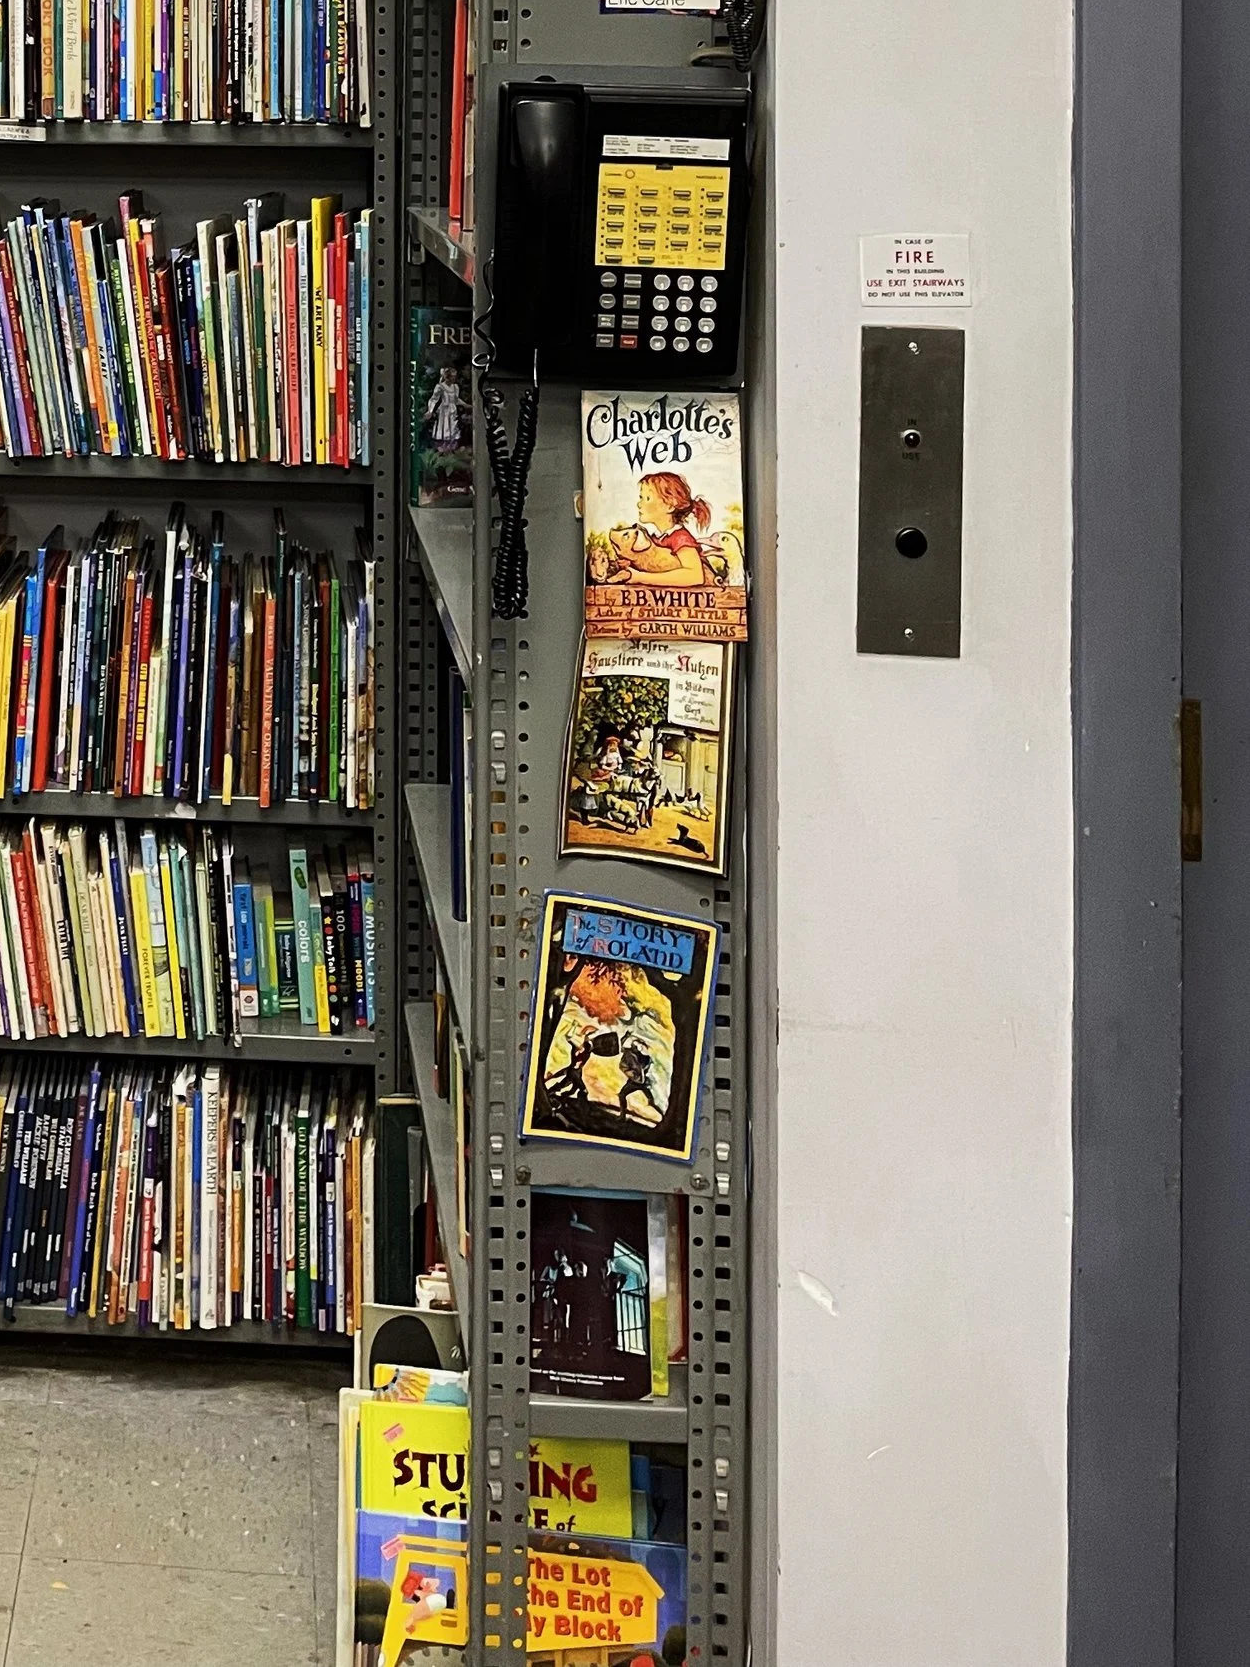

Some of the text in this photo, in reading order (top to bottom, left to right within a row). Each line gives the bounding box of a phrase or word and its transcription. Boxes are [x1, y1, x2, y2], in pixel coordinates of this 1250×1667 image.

[43, 37, 54, 77] BOOK
[895, 251, 934, 263] FIRE
[315, 288, 322, 301] WE
[888, 279, 907, 287] EXIT
[913, 279, 965, 287] STAIRWAYS
[288, 304, 297, 349] THE MAGIC
[315, 325, 323, 347] MANY
[586, 394, 733, 449] Charlotte's
[621, 428, 693, 476] Web
[653, 590, 717, 609] WHITE
[688, 609, 728, 621] LITTLE
[638, 623, 678, 634] GARTH
[263, 658, 275, 770] VALENTINE ORSON
[336, 909, 346, 932] 100
[598, 918, 684, 948] STORY
[299, 919, 311, 964] colors
[366, 915, 375, 966] MUSIC
[576, 935, 683, 969] of ROLAND
[142, 948, 151, 979] FOREVER
[355, 959, 364, 993] MOODS
[24, 1130, 32, 1145] TED
[205, 1091, 218, 1196] KEEPERS EARTH
[298, 1126, 307, 1270] GO IN AND OUT THE WINDOW
[571, 1560, 611, 1589] Lot
[567, 1588, 644, 1619] End of
[554, 1615, 621, 1643] Block
